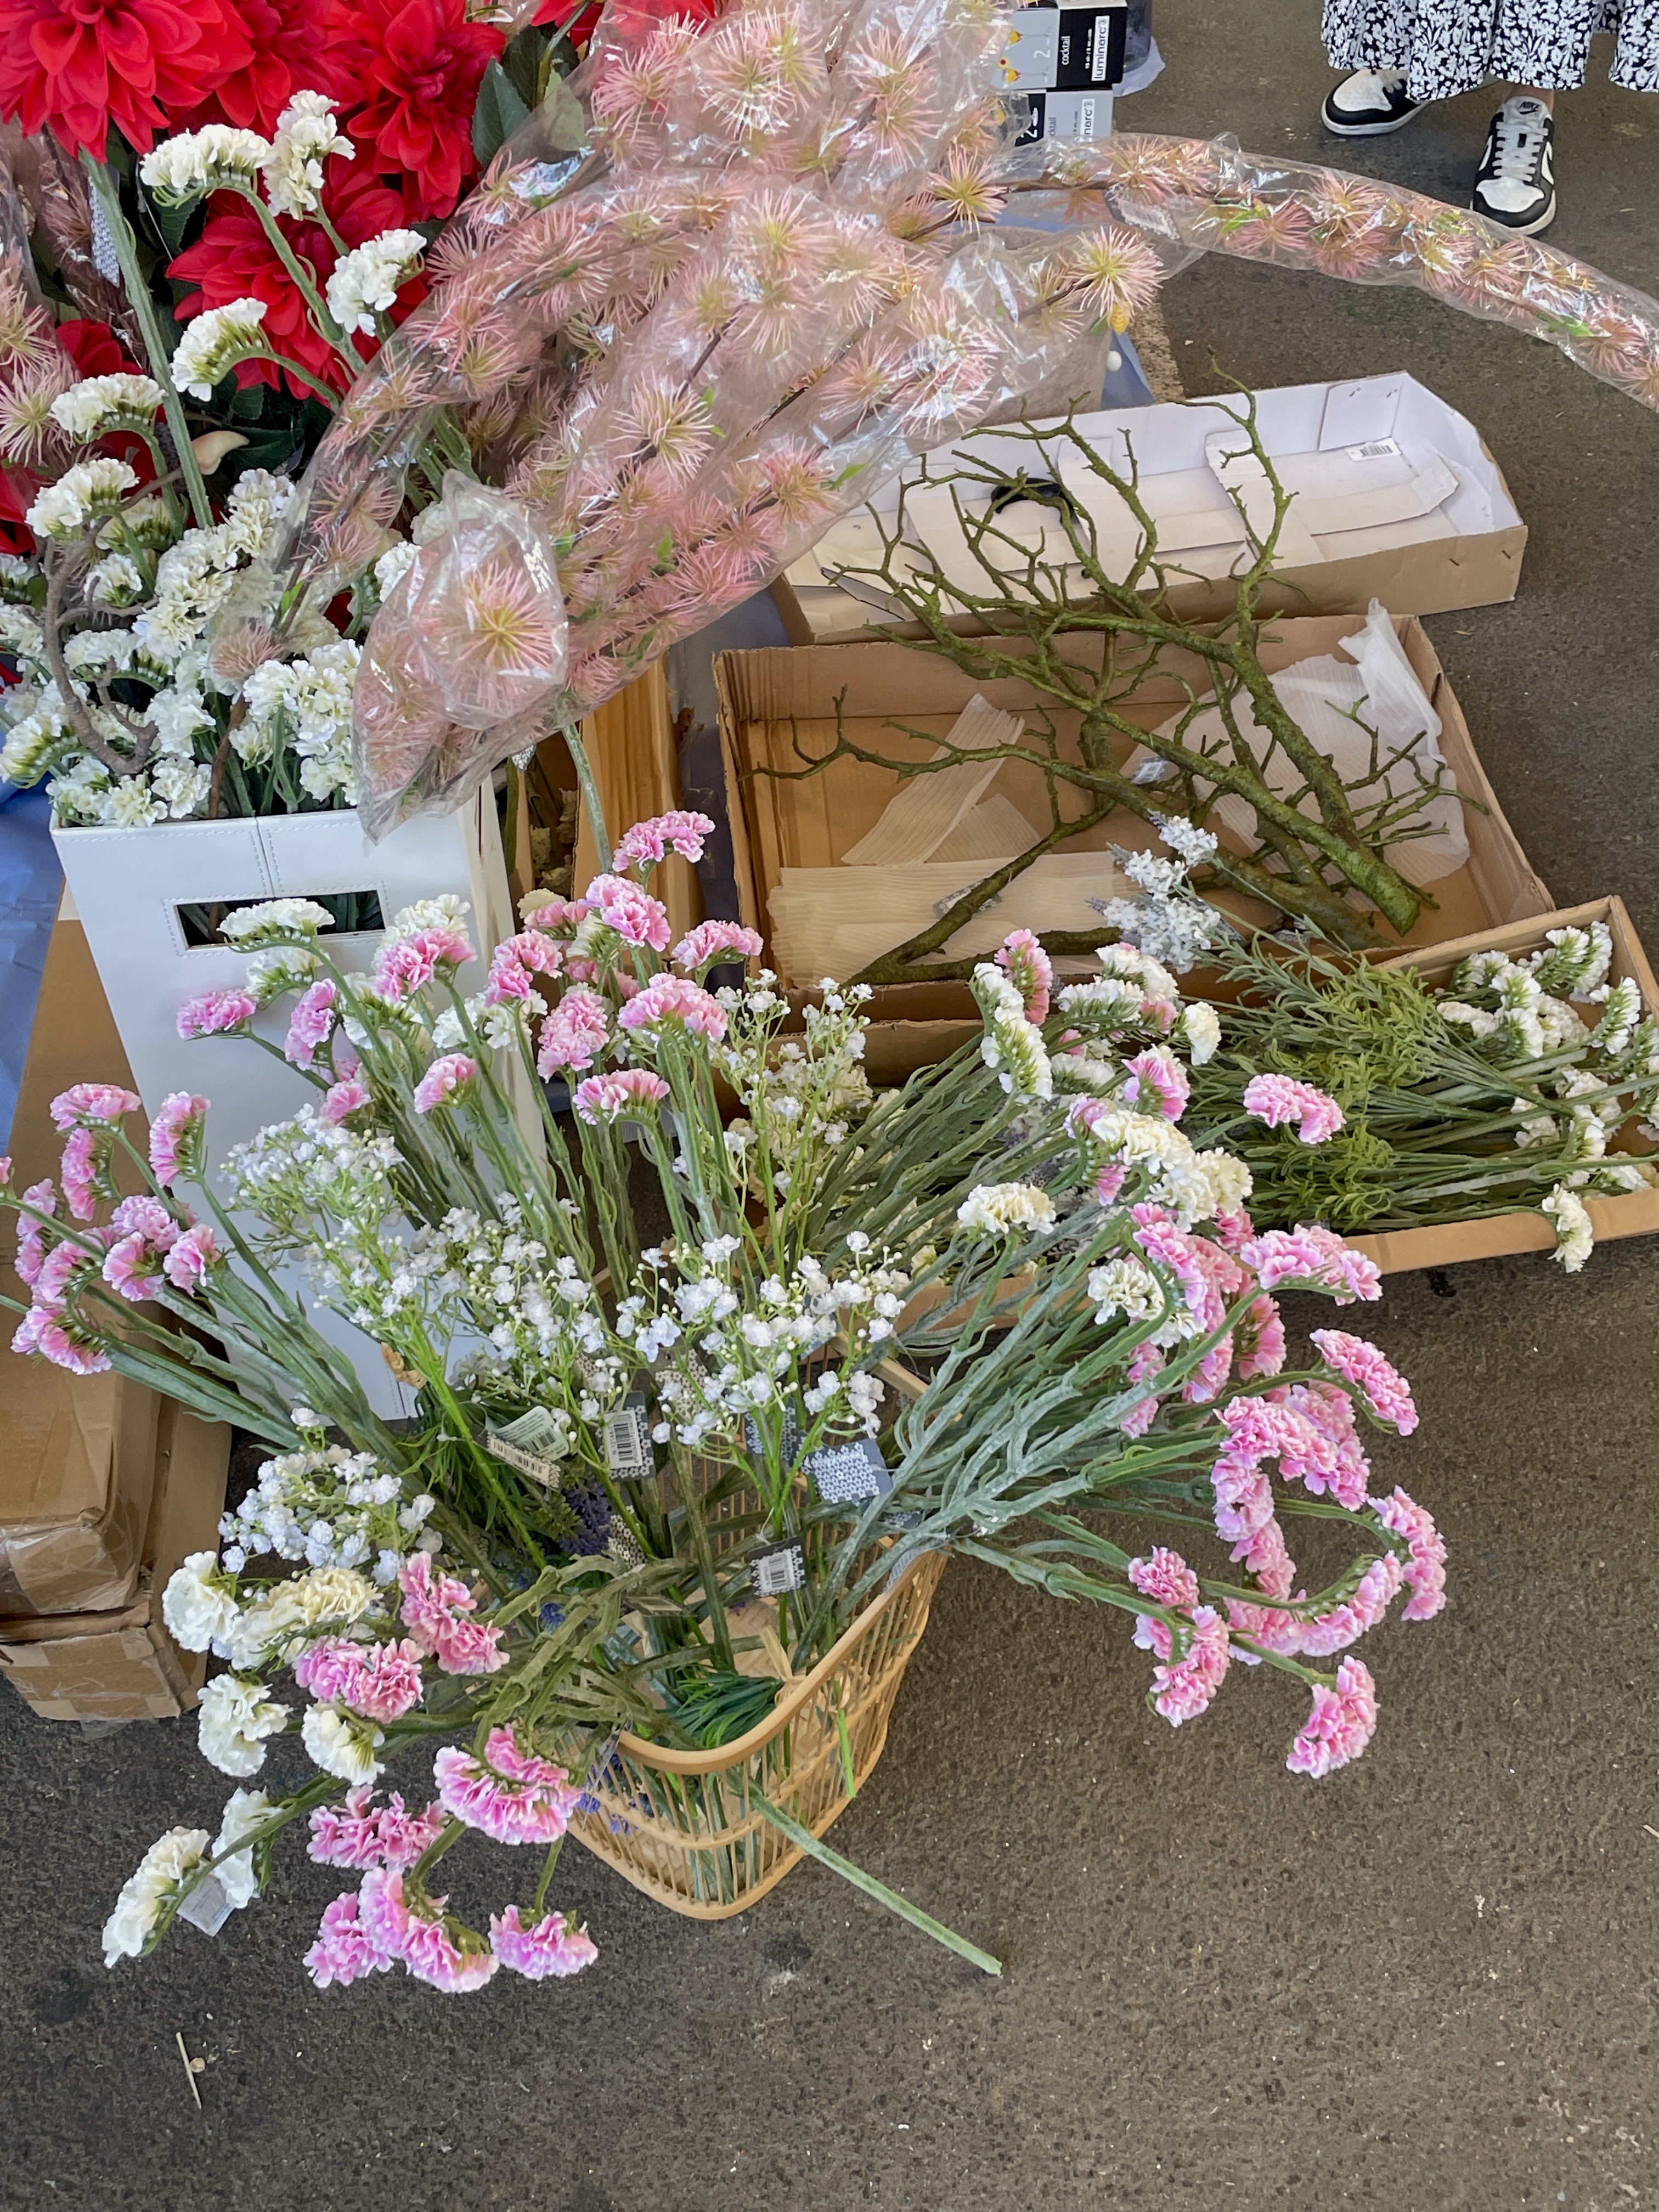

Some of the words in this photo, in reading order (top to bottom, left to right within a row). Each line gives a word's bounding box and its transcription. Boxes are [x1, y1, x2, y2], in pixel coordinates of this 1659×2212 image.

[1033, 49, 1051, 59] 2
[1060, 36, 1070, 65] cocktail
[1094, 27, 1107, 79] luminarc
[1048, 117, 1056, 137] cktail
[1084, 108, 1093, 135] narc
